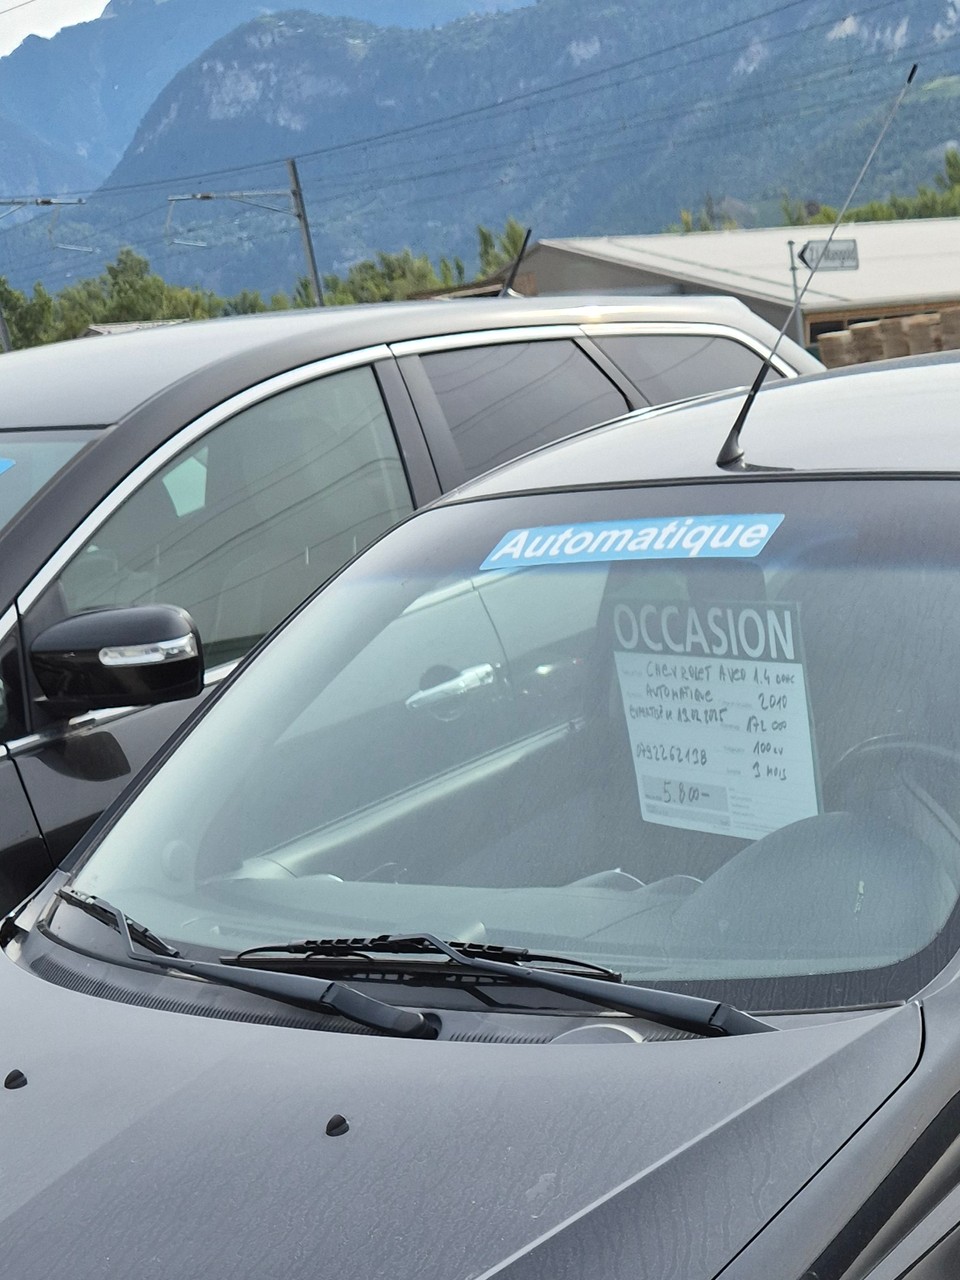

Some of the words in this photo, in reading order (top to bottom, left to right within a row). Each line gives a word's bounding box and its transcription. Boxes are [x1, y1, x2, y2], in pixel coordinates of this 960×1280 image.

[490, 518, 769, 560] Automatique
[613, 603, 795, 660] OCCASION
[753, 666, 770, 685] 1.4
[758, 692, 787, 711] 2010
[753, 740, 771, 755] 100
